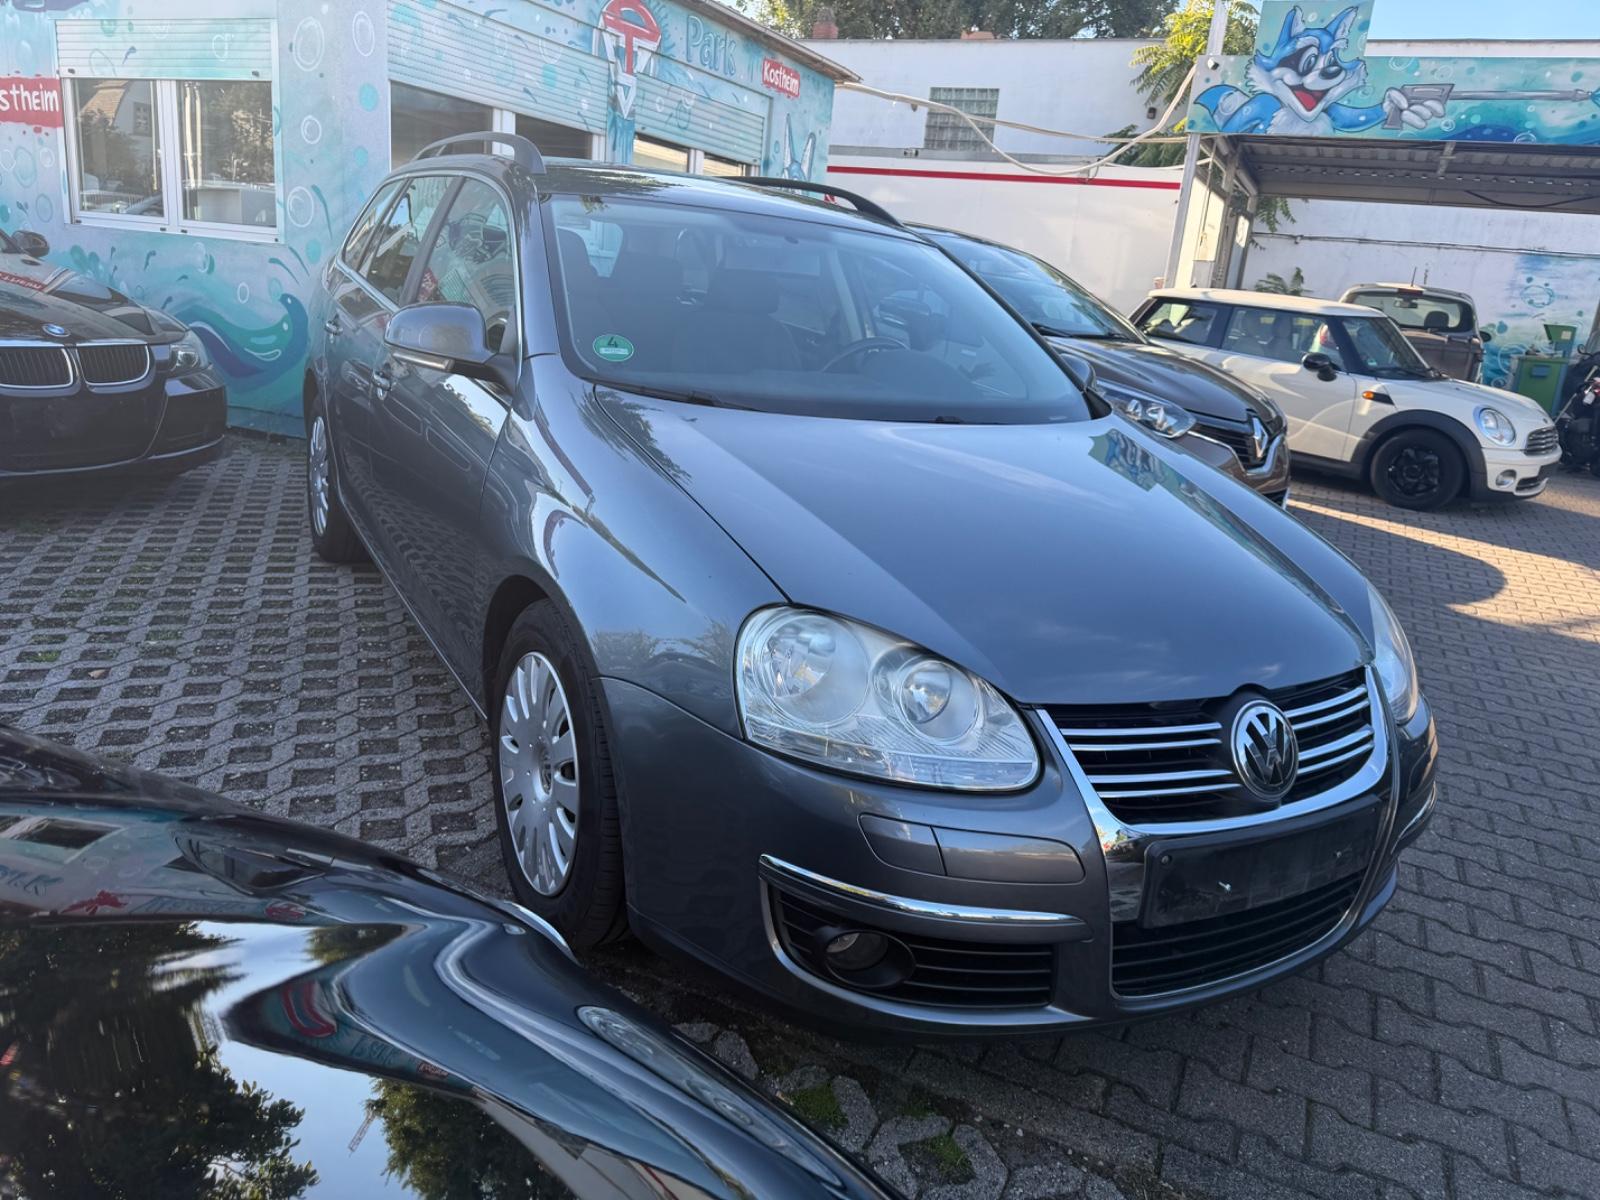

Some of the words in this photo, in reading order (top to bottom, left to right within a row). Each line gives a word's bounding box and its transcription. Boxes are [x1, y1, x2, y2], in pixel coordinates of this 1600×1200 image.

[686, 15, 737, 76] Park
[0, 83, 59, 112] stheim
[764, 59, 800, 97] Kostheim
[1236, 705, 1294, 792] VW
